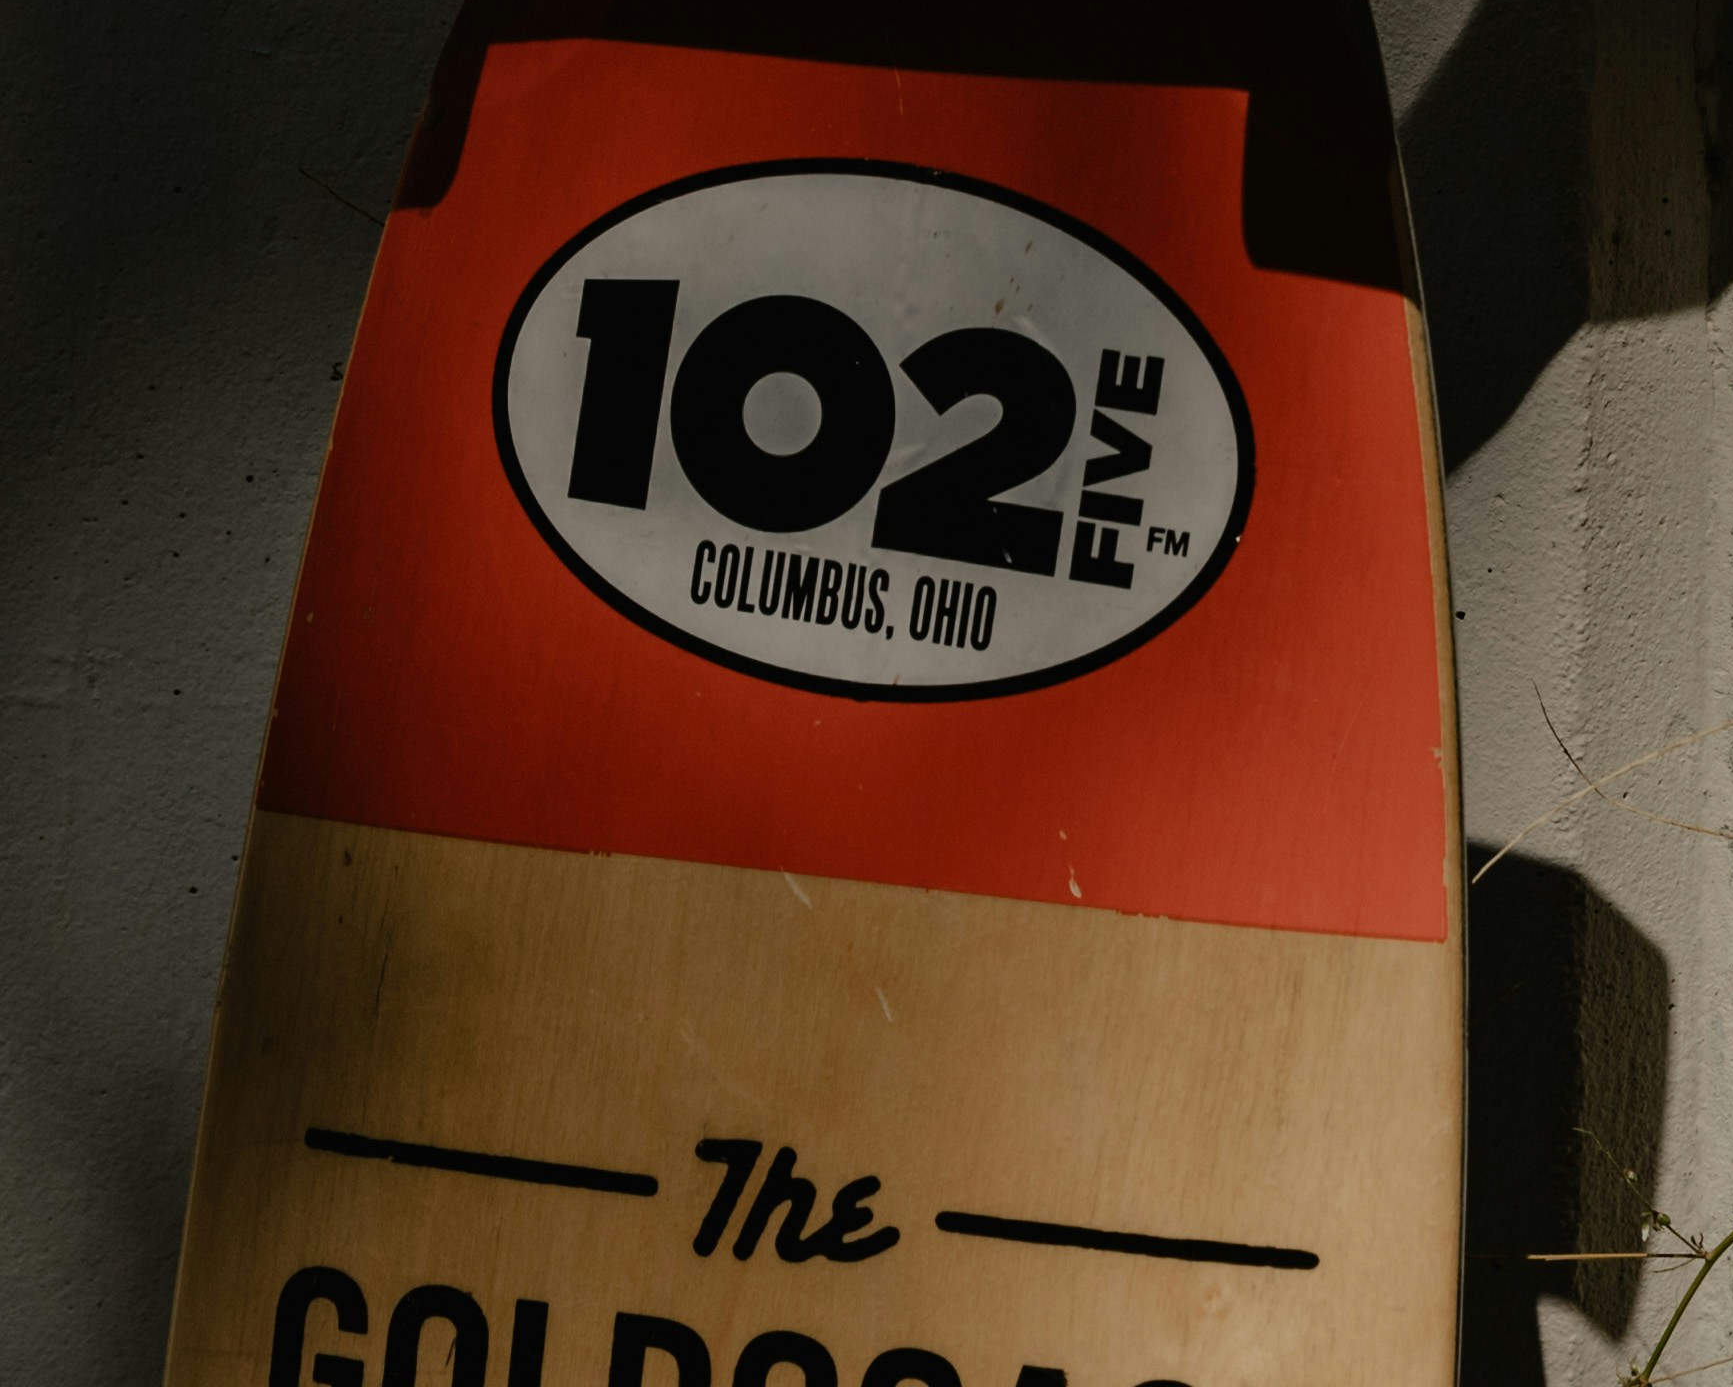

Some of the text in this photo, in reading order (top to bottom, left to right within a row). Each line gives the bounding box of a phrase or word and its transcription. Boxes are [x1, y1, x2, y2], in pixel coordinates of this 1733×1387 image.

[567, 278, 1077, 578] 102
[1068, 348, 1166, 590] FIVE
[690, 539, 998, 653] COLUMBUS, OHIO
[1145, 526, 1191, 559] FM
[692, 1138, 901, 1264] The
